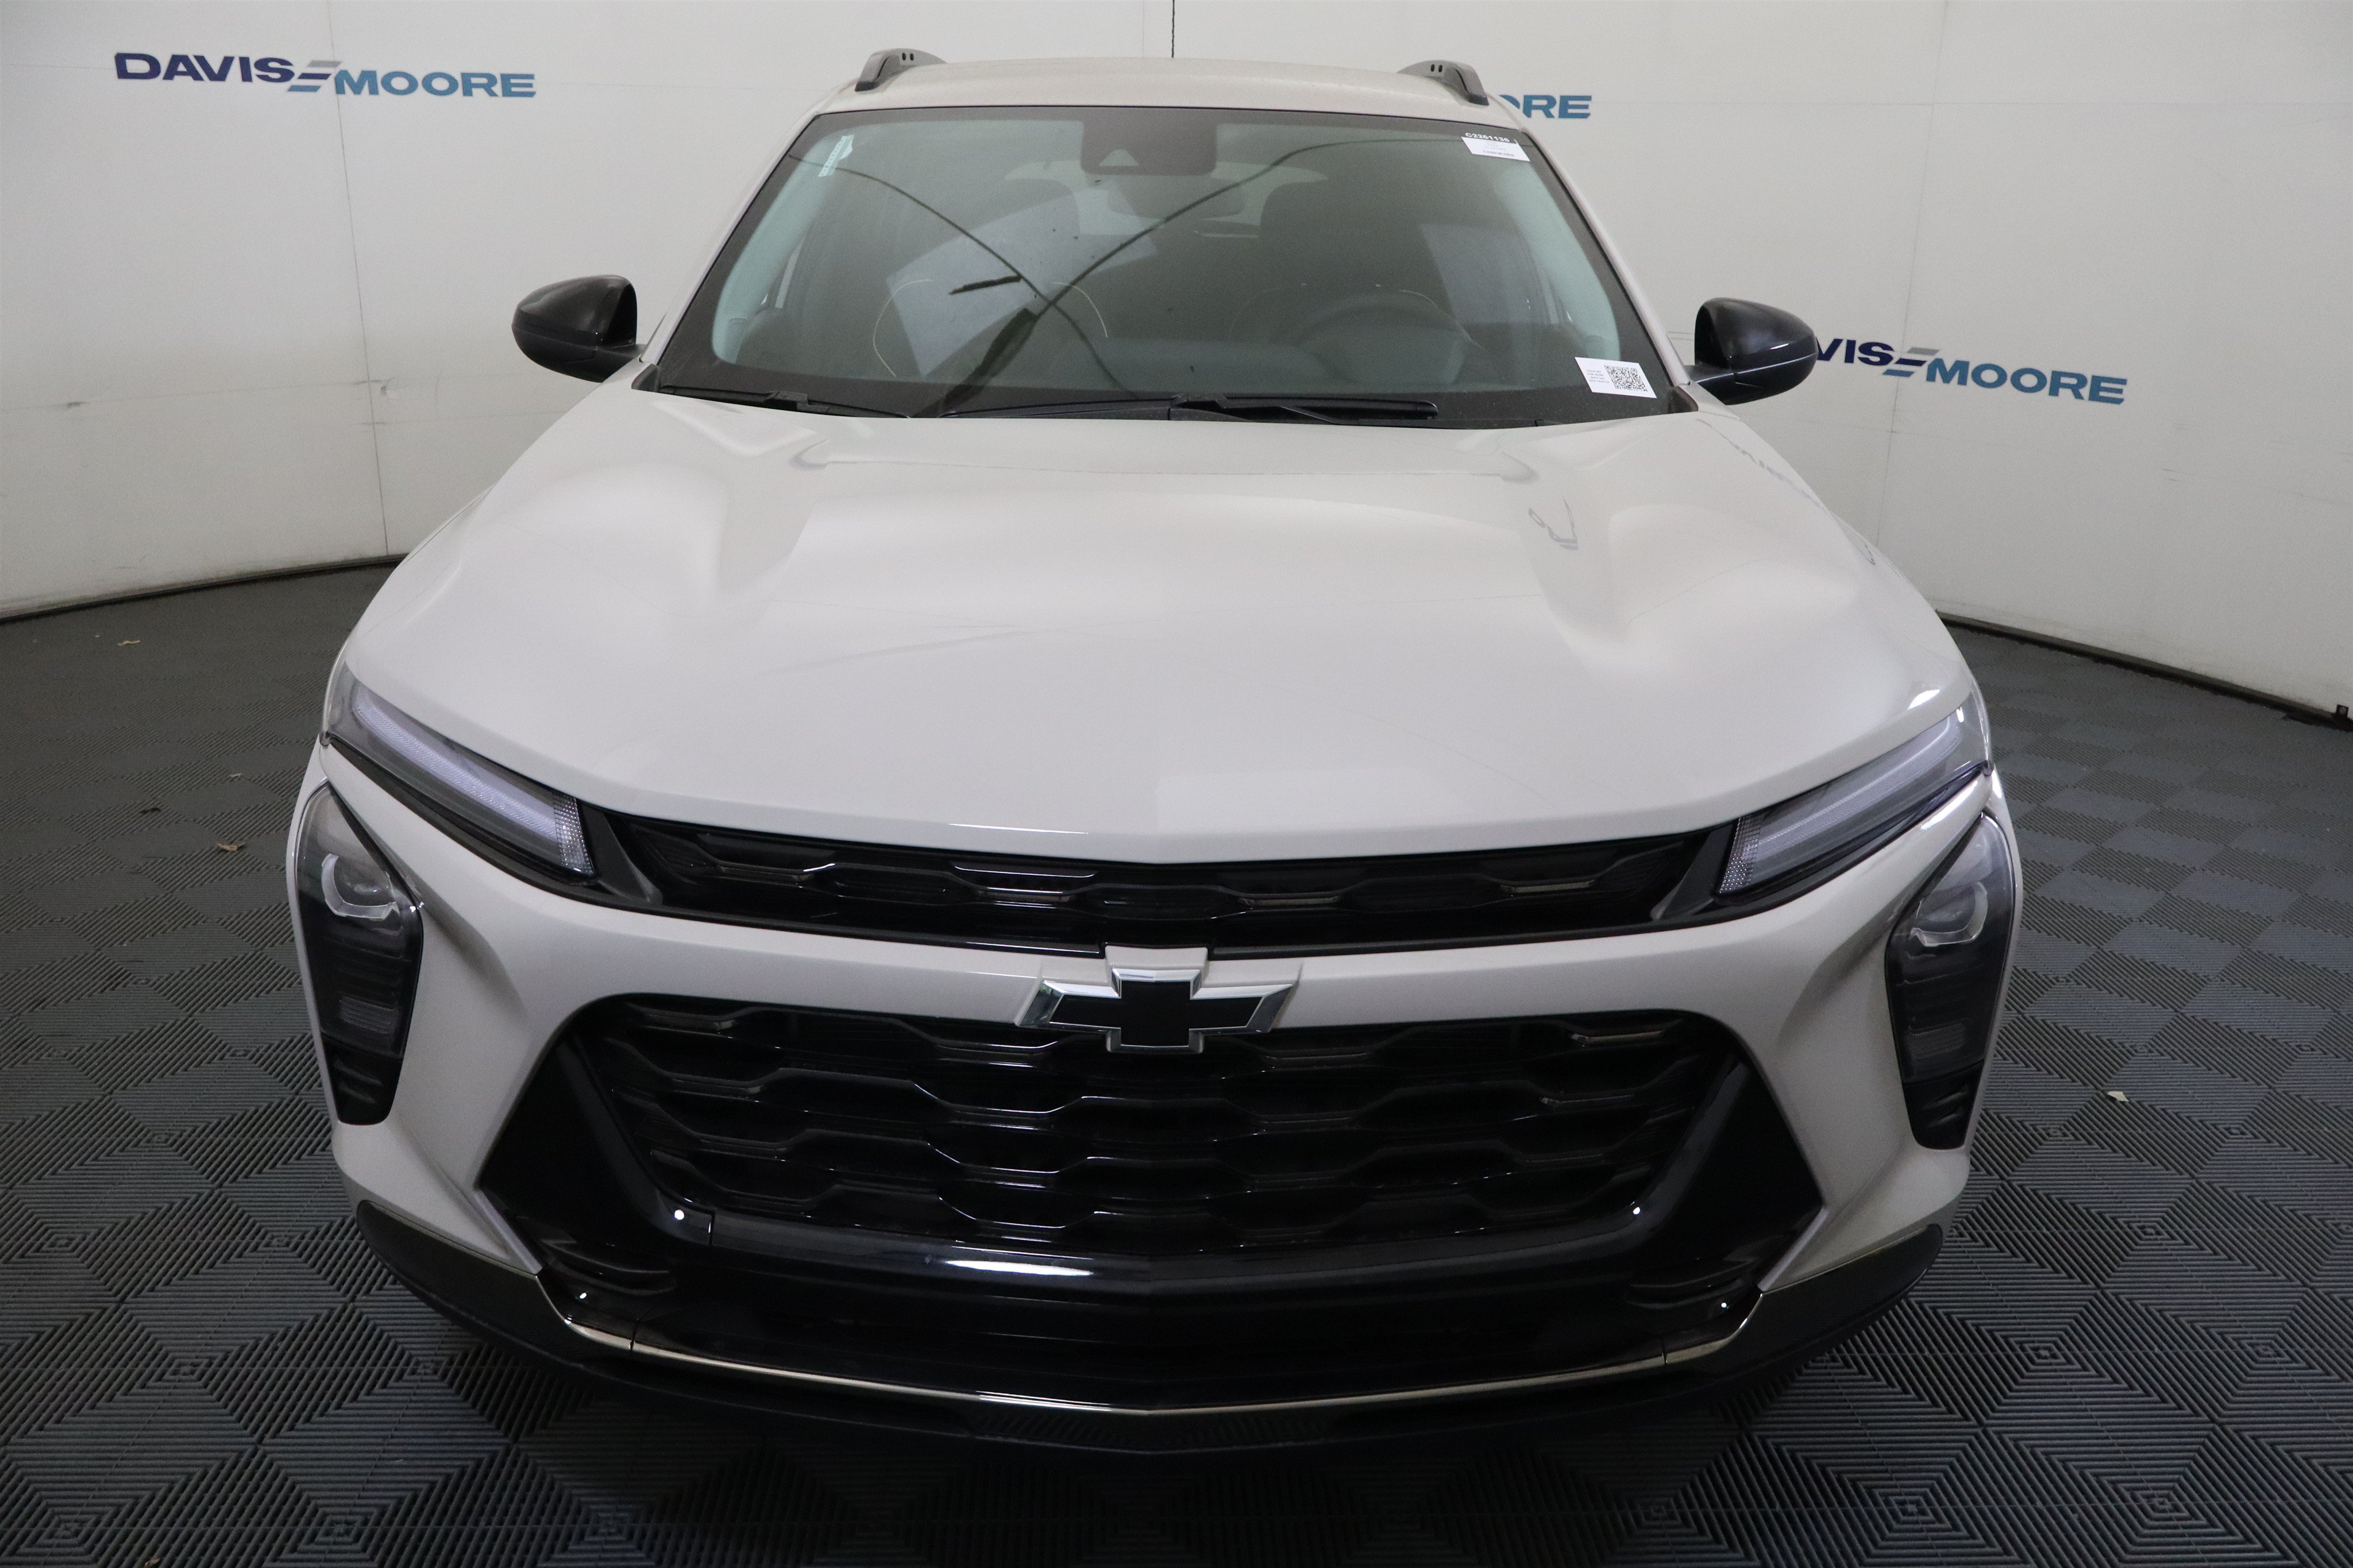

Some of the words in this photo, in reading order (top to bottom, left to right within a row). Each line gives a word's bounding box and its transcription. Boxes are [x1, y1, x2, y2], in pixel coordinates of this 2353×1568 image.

[115, 53, 294, 83] DAVIS
[334, 69, 537, 98] MOORE
[1926, 358, 2127, 404] MOORE
